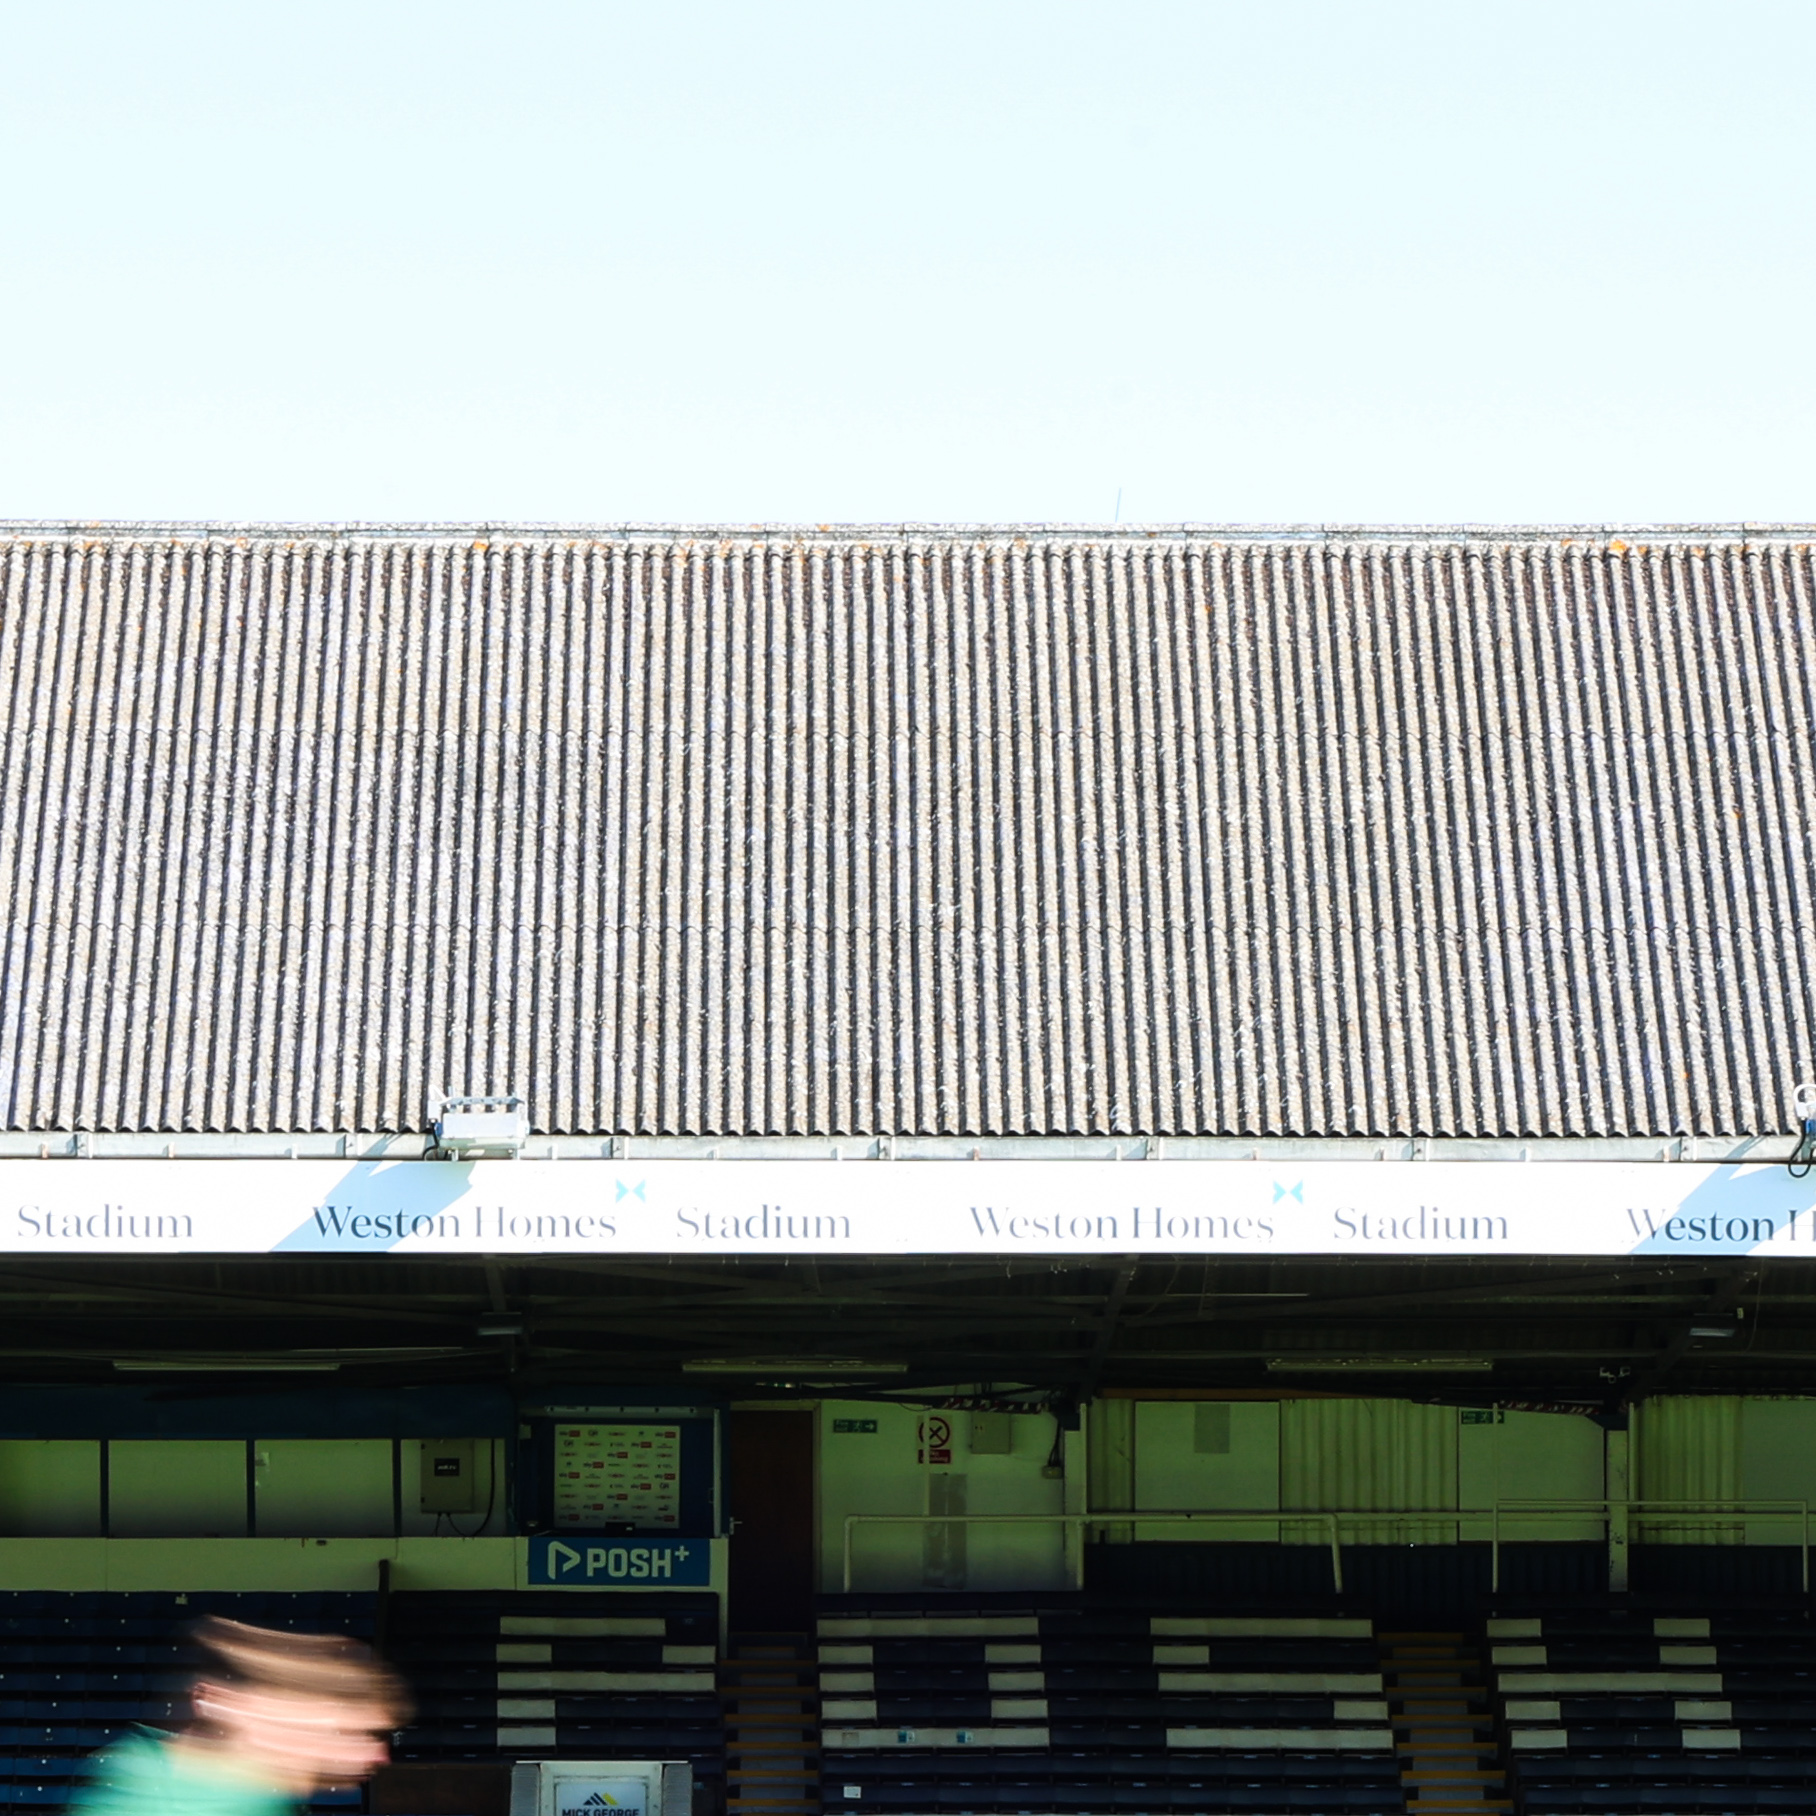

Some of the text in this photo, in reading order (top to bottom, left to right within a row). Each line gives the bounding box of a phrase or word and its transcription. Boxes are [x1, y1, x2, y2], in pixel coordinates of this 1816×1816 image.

[17, 1202, 194, 1239] Stadium
[312, 1204, 853, 1240] Weston Homes Stadium
[969, 1206, 1509, 1241] Weston Homes Stadium
[1626, 1207, 1775, 1243] Weston
